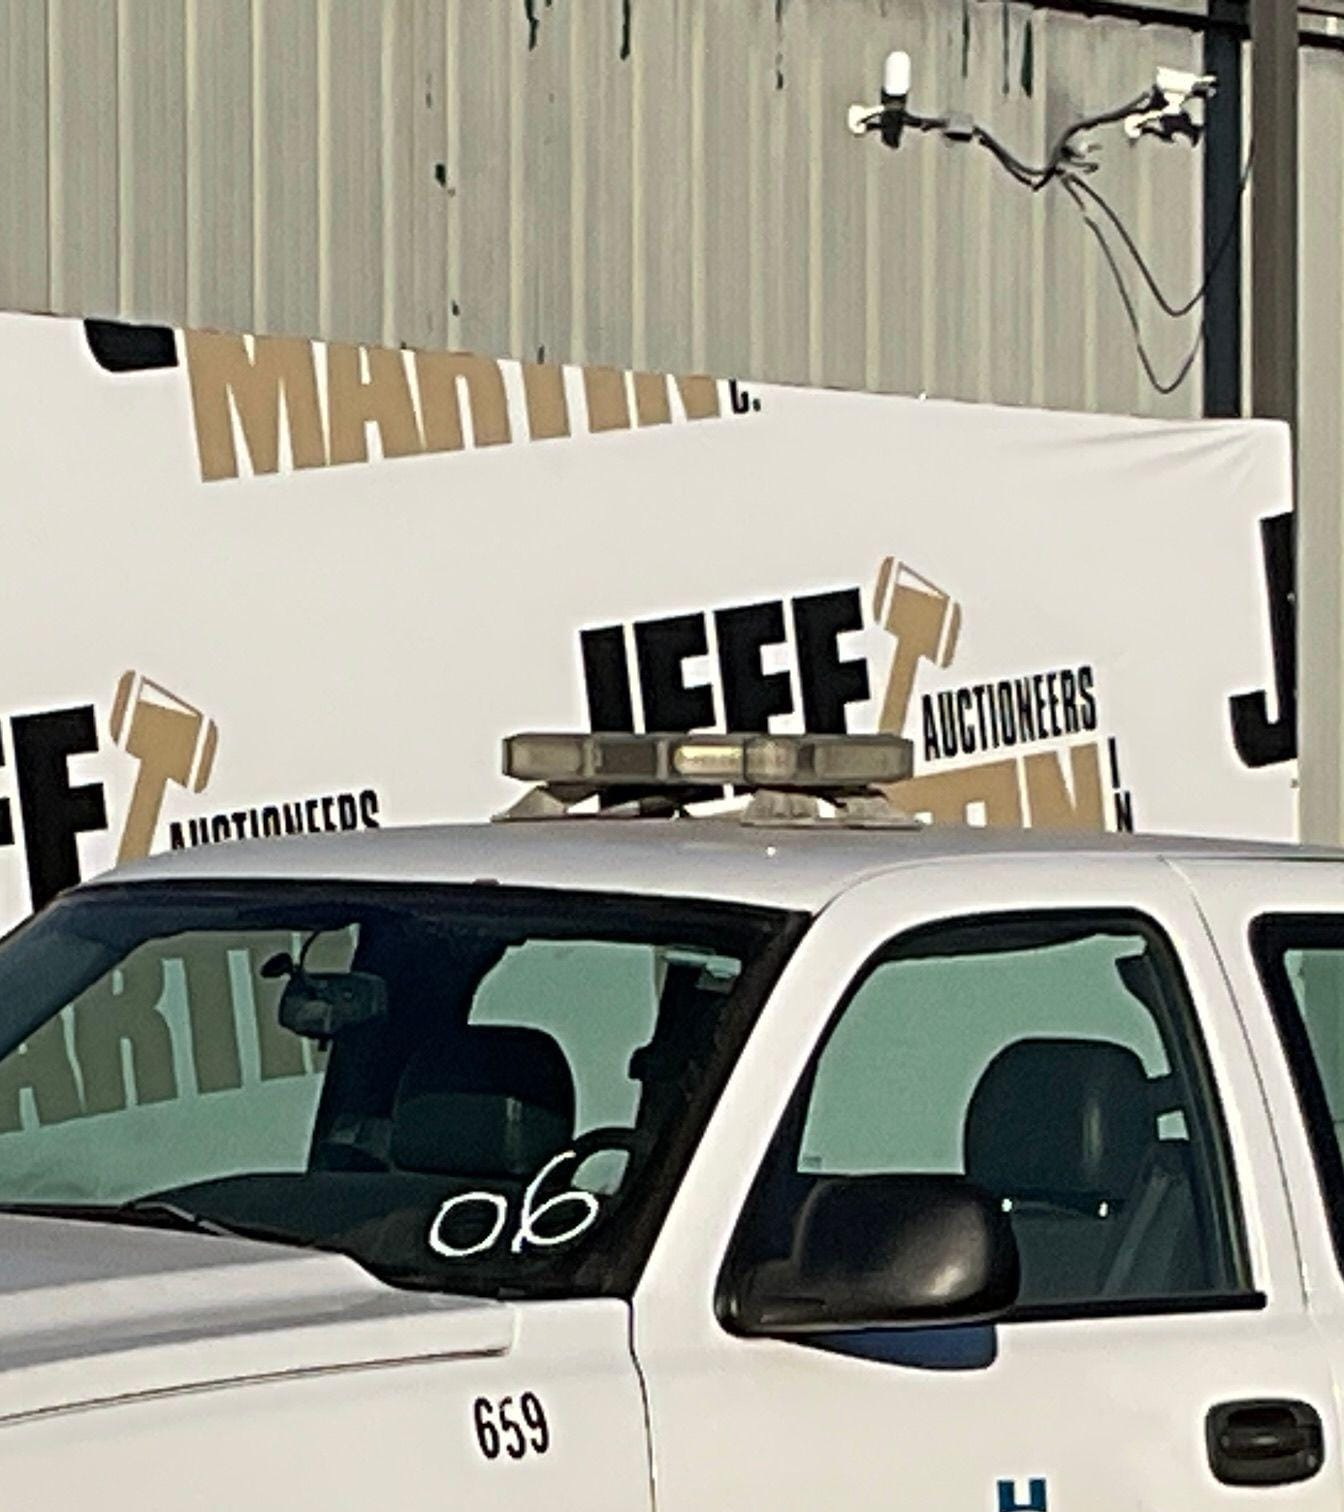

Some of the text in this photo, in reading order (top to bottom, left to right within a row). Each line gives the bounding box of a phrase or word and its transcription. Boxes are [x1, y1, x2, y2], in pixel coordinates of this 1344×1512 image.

[921, 665, 1098, 762] AUCTIONEERS
[429, 1149, 599, 1257] 06
[473, 1391, 549, 1460] 659
